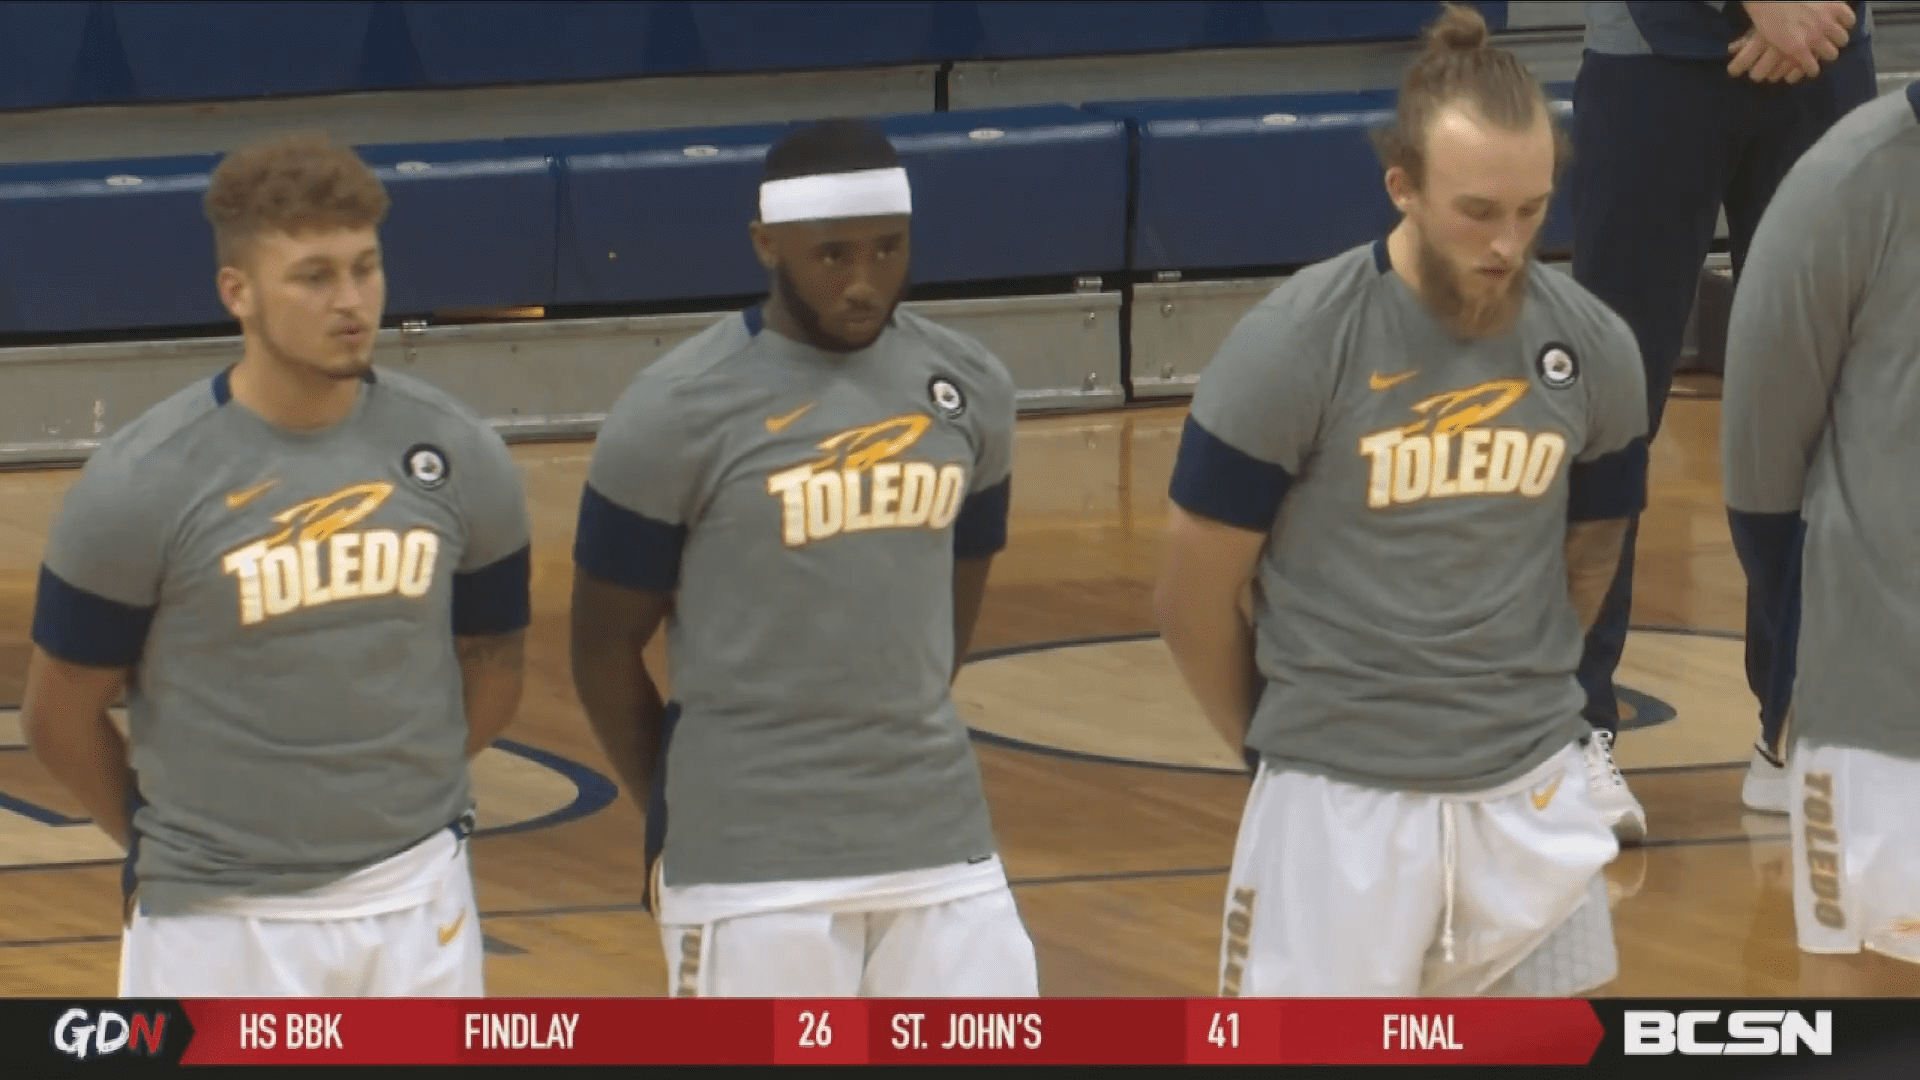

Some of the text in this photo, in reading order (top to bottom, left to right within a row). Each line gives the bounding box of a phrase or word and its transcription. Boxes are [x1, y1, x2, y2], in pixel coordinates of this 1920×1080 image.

[767, 461, 964, 548] TOLEDO
[1359, 426, 1567, 510] TOLEDO
[222, 527, 440, 627] TOLEDO
[1803, 772, 1846, 930] TOLEDO
